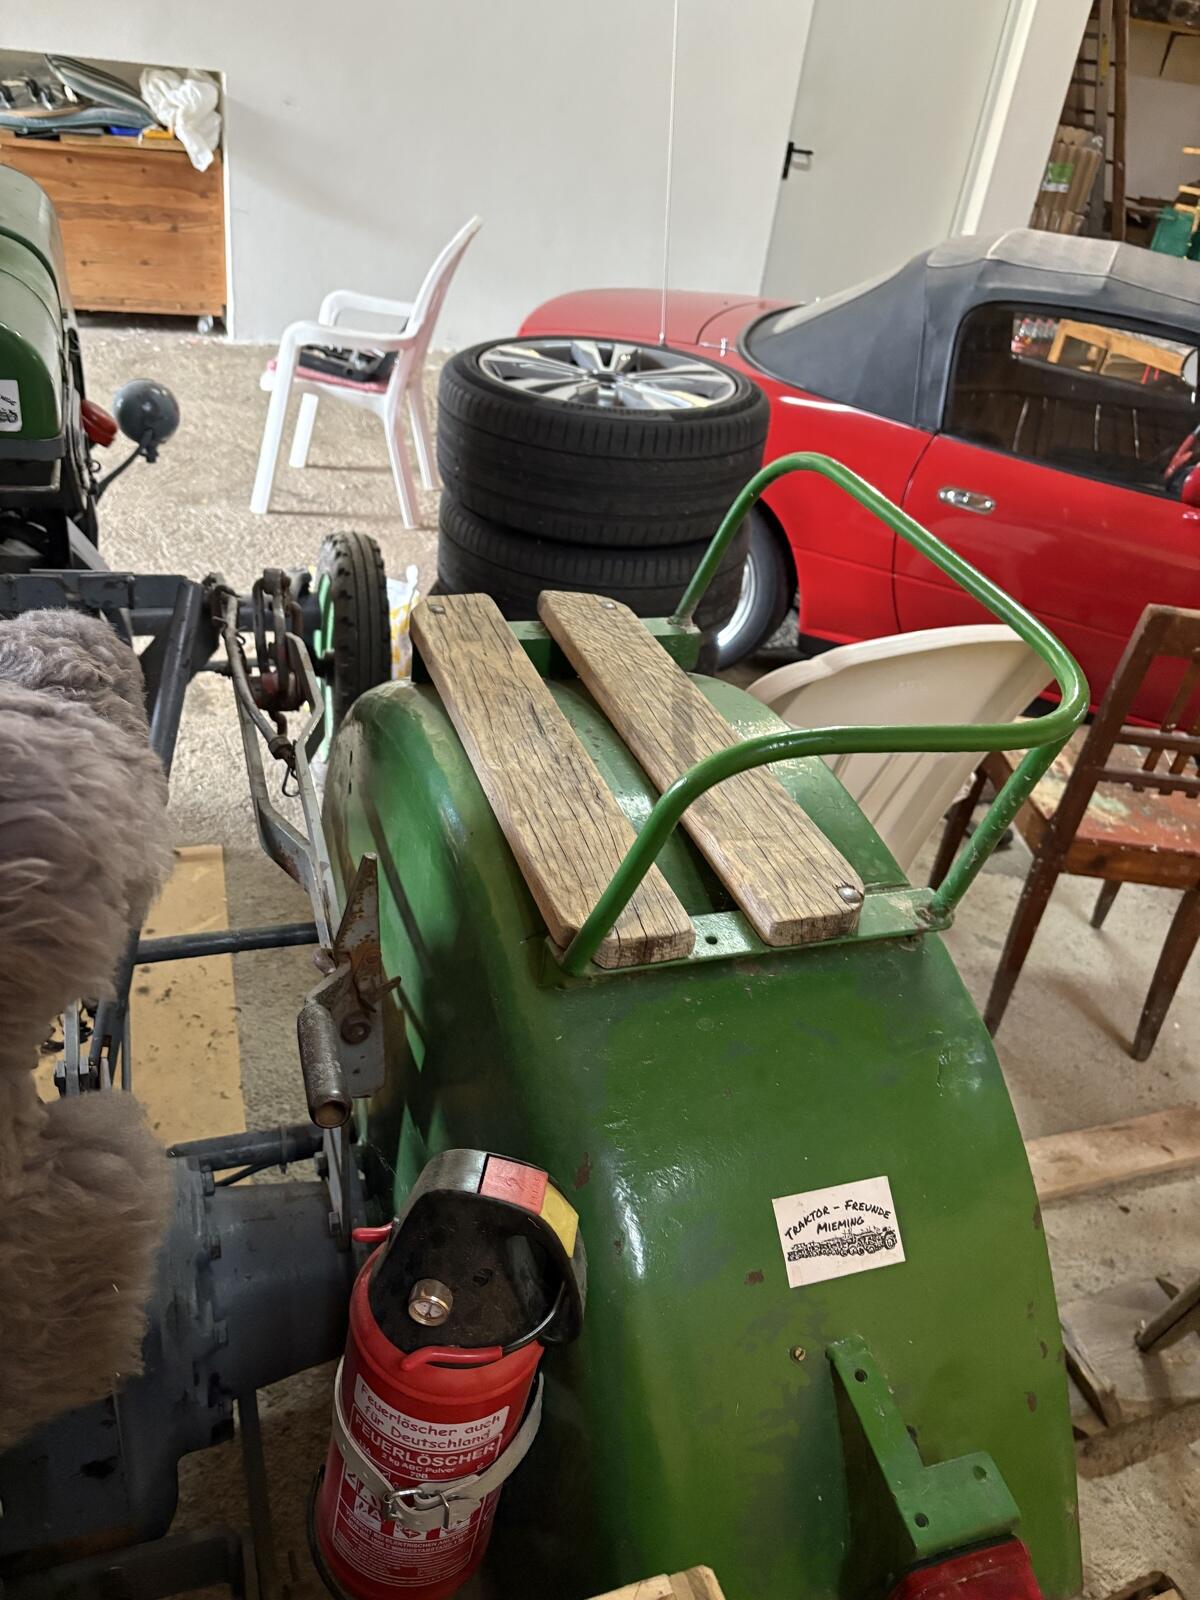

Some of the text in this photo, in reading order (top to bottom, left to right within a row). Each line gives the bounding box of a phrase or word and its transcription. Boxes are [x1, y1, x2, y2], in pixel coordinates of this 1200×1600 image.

[784, 1205, 831, 1241] TRAKTOR
[844, 1199, 892, 1220] FREUNDE
[816, 1216, 865, 1235] MIEMING
[361, 1383, 501, 1437] Feuerlöscher auch
[364, 1405, 491, 1449] für Deutschland
[354, 1414, 496, 1467] FEUERLÖSCHER
[401, 1462, 423, 1472] ABC
[425, 1466, 456, 1475] Pulver
